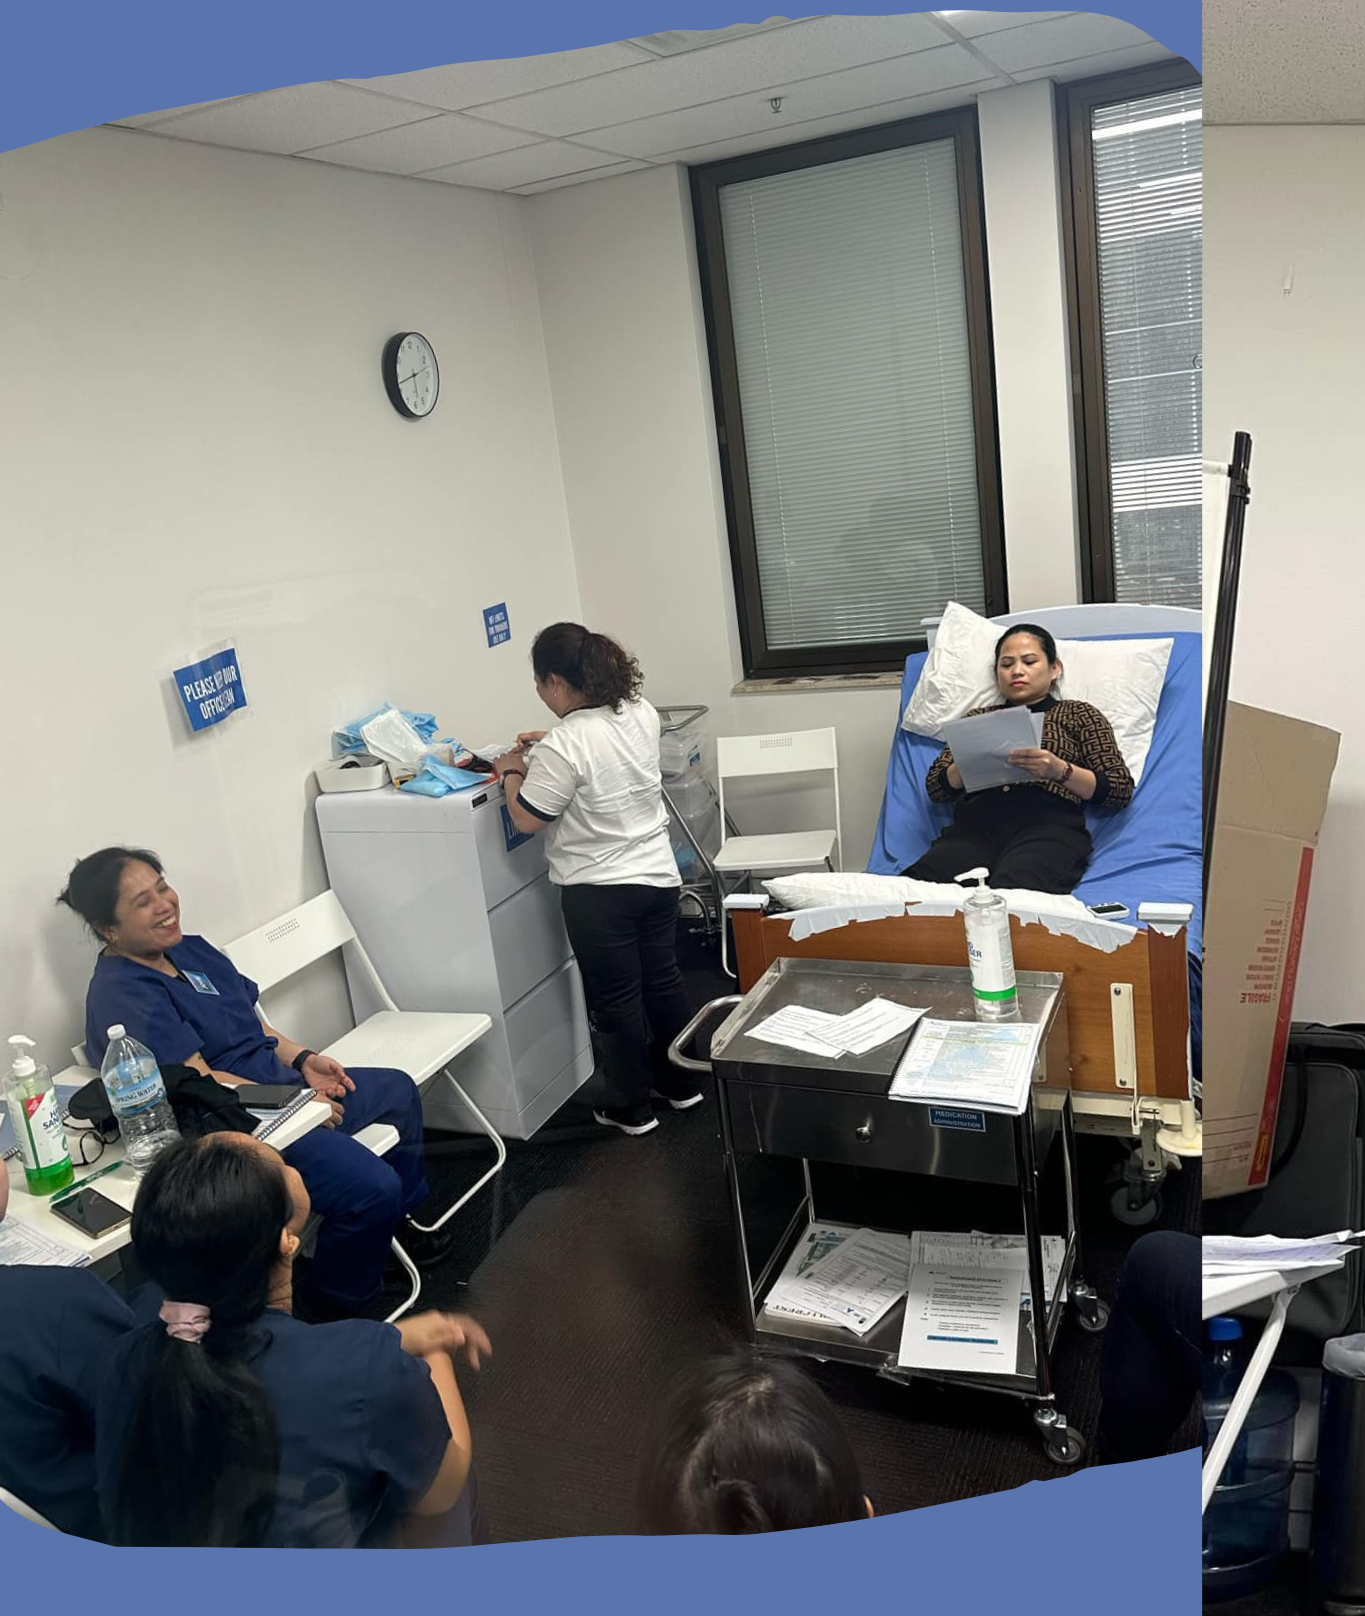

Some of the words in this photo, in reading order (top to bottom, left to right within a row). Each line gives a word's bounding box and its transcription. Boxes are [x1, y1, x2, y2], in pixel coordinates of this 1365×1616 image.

[183, 676, 216, 702] PLEASE
[222, 665, 238, 684] OUR
[200, 695, 225, 720] OFFICE
[1240, 992, 1271, 1003] FRAGILE
[935, 1110, 978, 1120] MEDICATION
[934, 1118, 981, 1128] ADMINISTRATION
